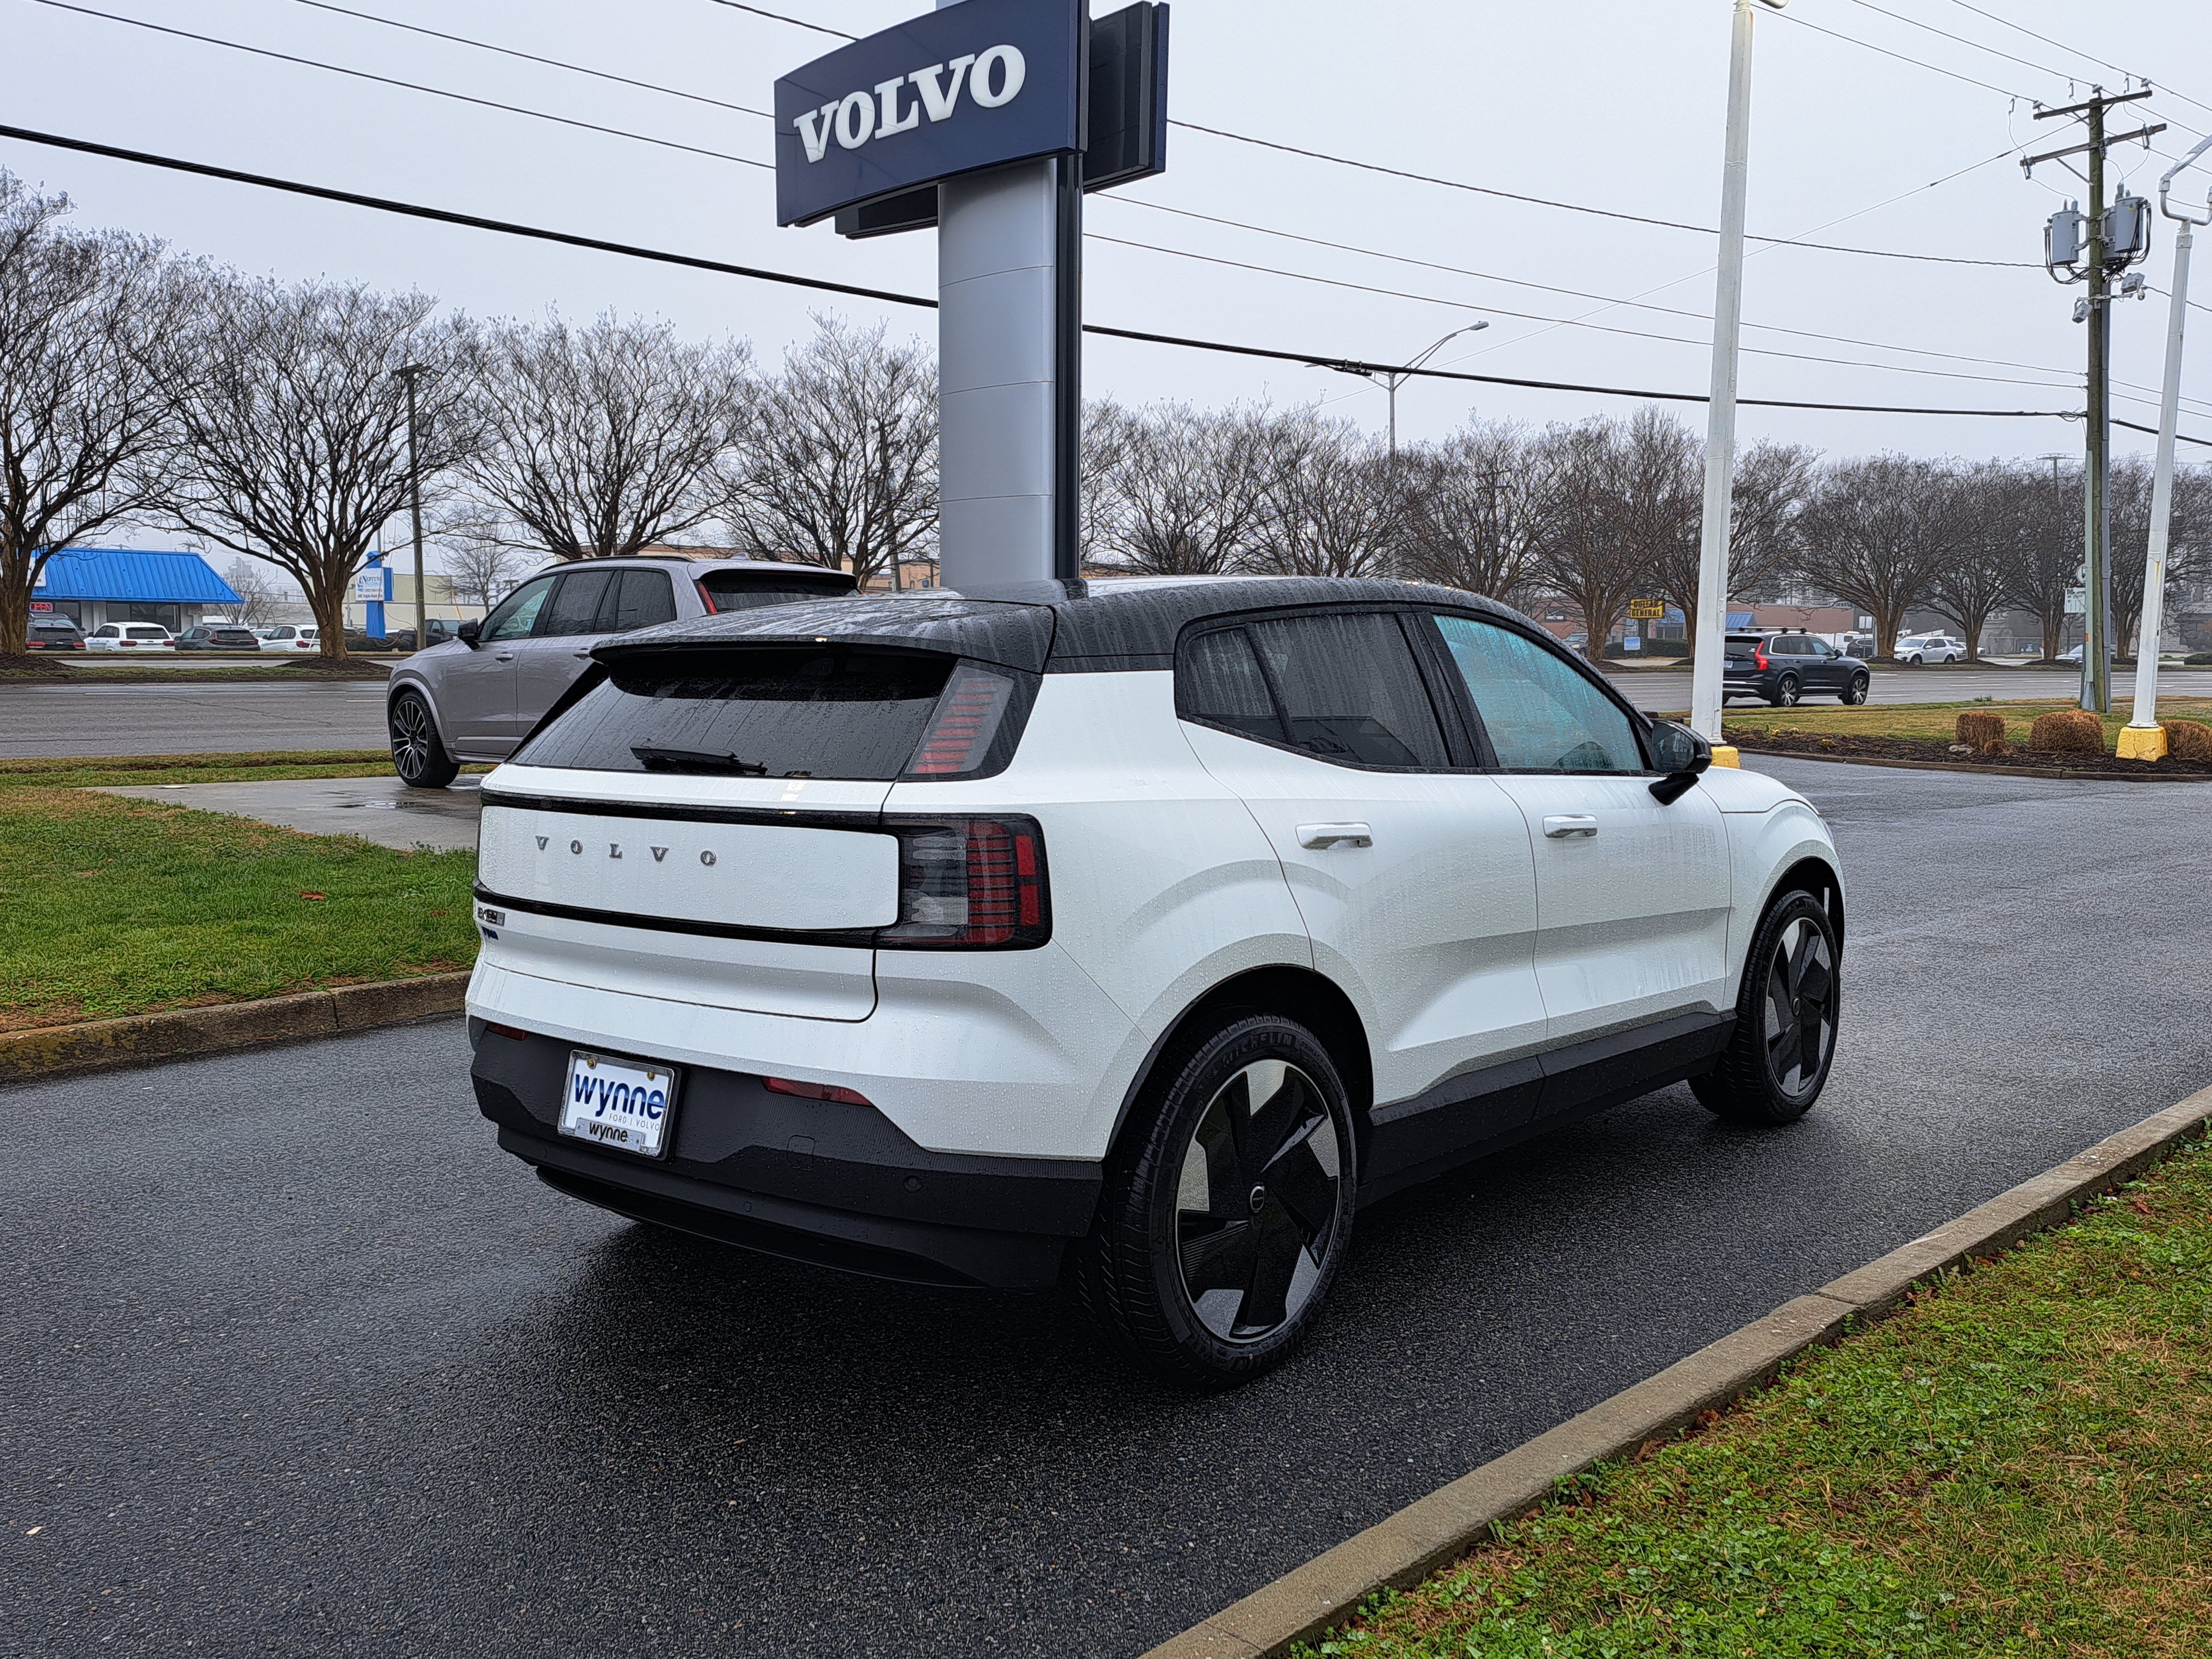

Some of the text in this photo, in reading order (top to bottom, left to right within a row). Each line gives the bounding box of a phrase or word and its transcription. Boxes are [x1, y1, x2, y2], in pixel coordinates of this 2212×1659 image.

[793, 44, 1026, 164] VOLVO
[535, 835, 717, 866] VOLVO
[575, 1074, 664, 1119] wynne
[589, 1122, 628, 1142] wynne
[609, 1113, 660, 1131] FORD VOLVO
